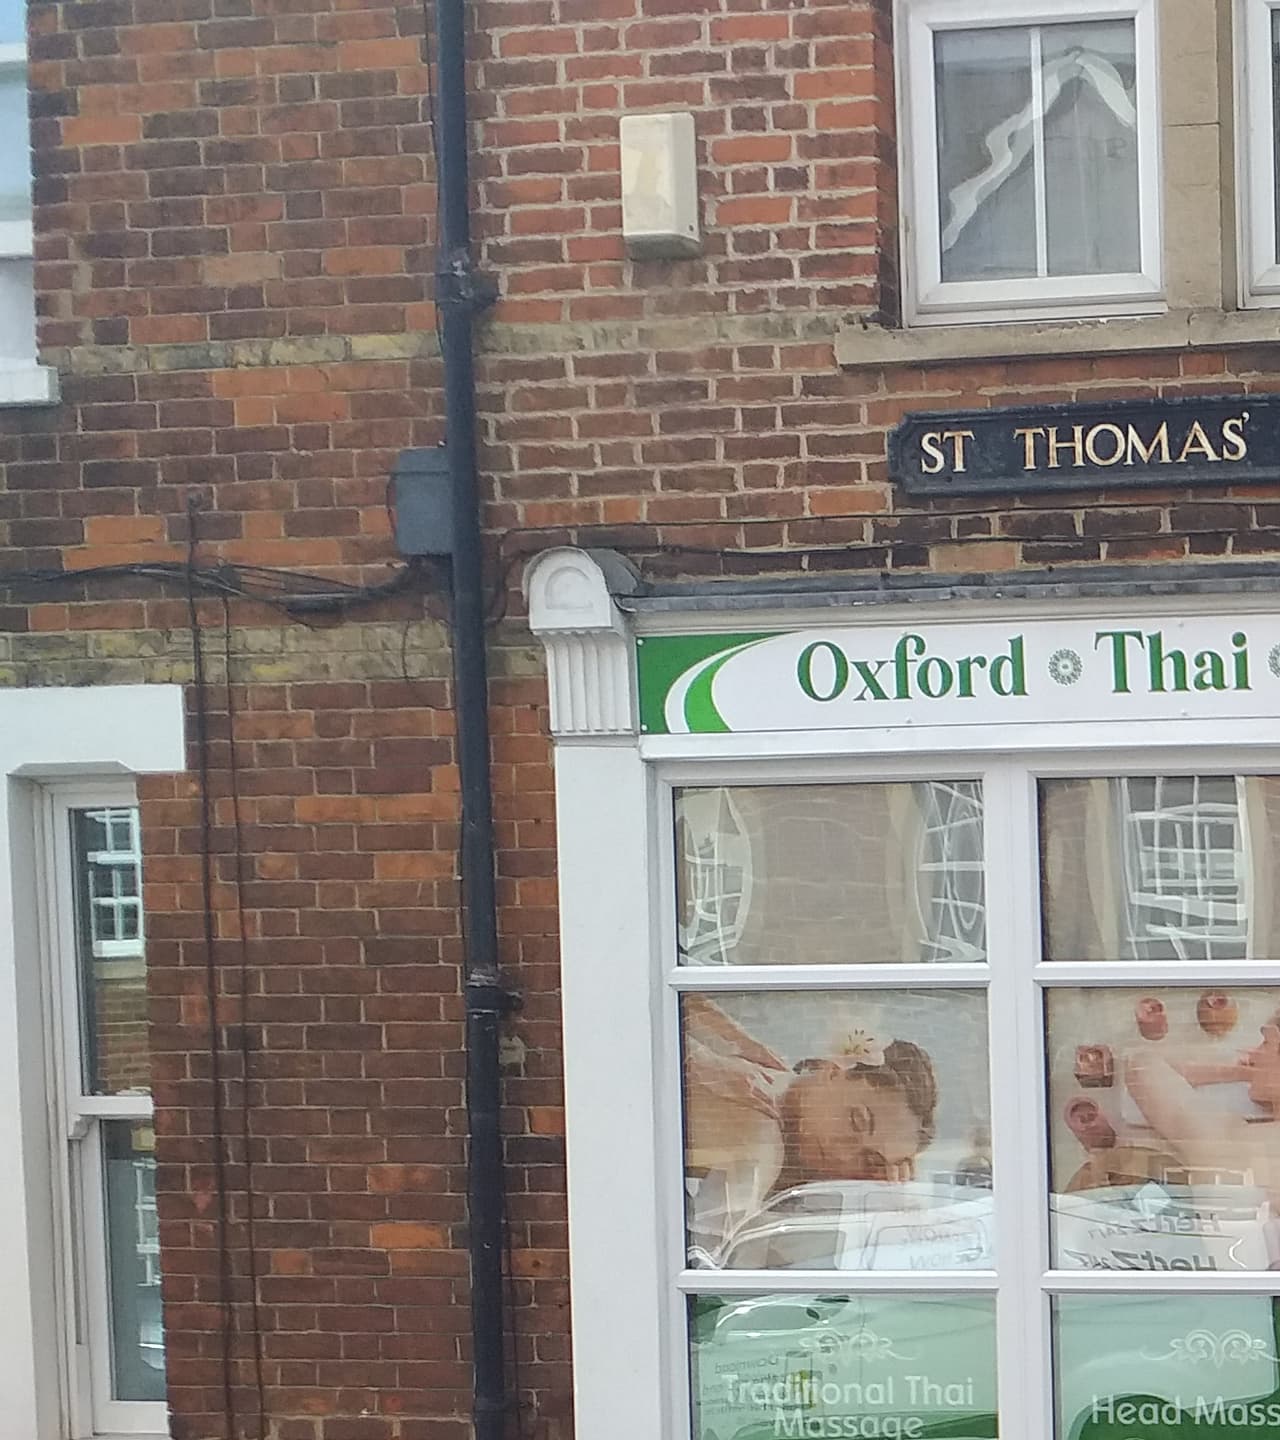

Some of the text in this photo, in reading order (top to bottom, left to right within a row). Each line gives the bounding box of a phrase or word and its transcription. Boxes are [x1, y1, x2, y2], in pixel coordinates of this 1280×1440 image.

[919, 429, 975, 475] ST
[1012, 411, 1251, 471] THOMAS'
[797, 634, 1029, 702] Oxford
[1094, 631, 1253, 693] Thai
[721, 1374, 894, 1405] Traditional
[904, 1375, 974, 1406] Thai
[1092, 1394, 1181, 1426] Head
